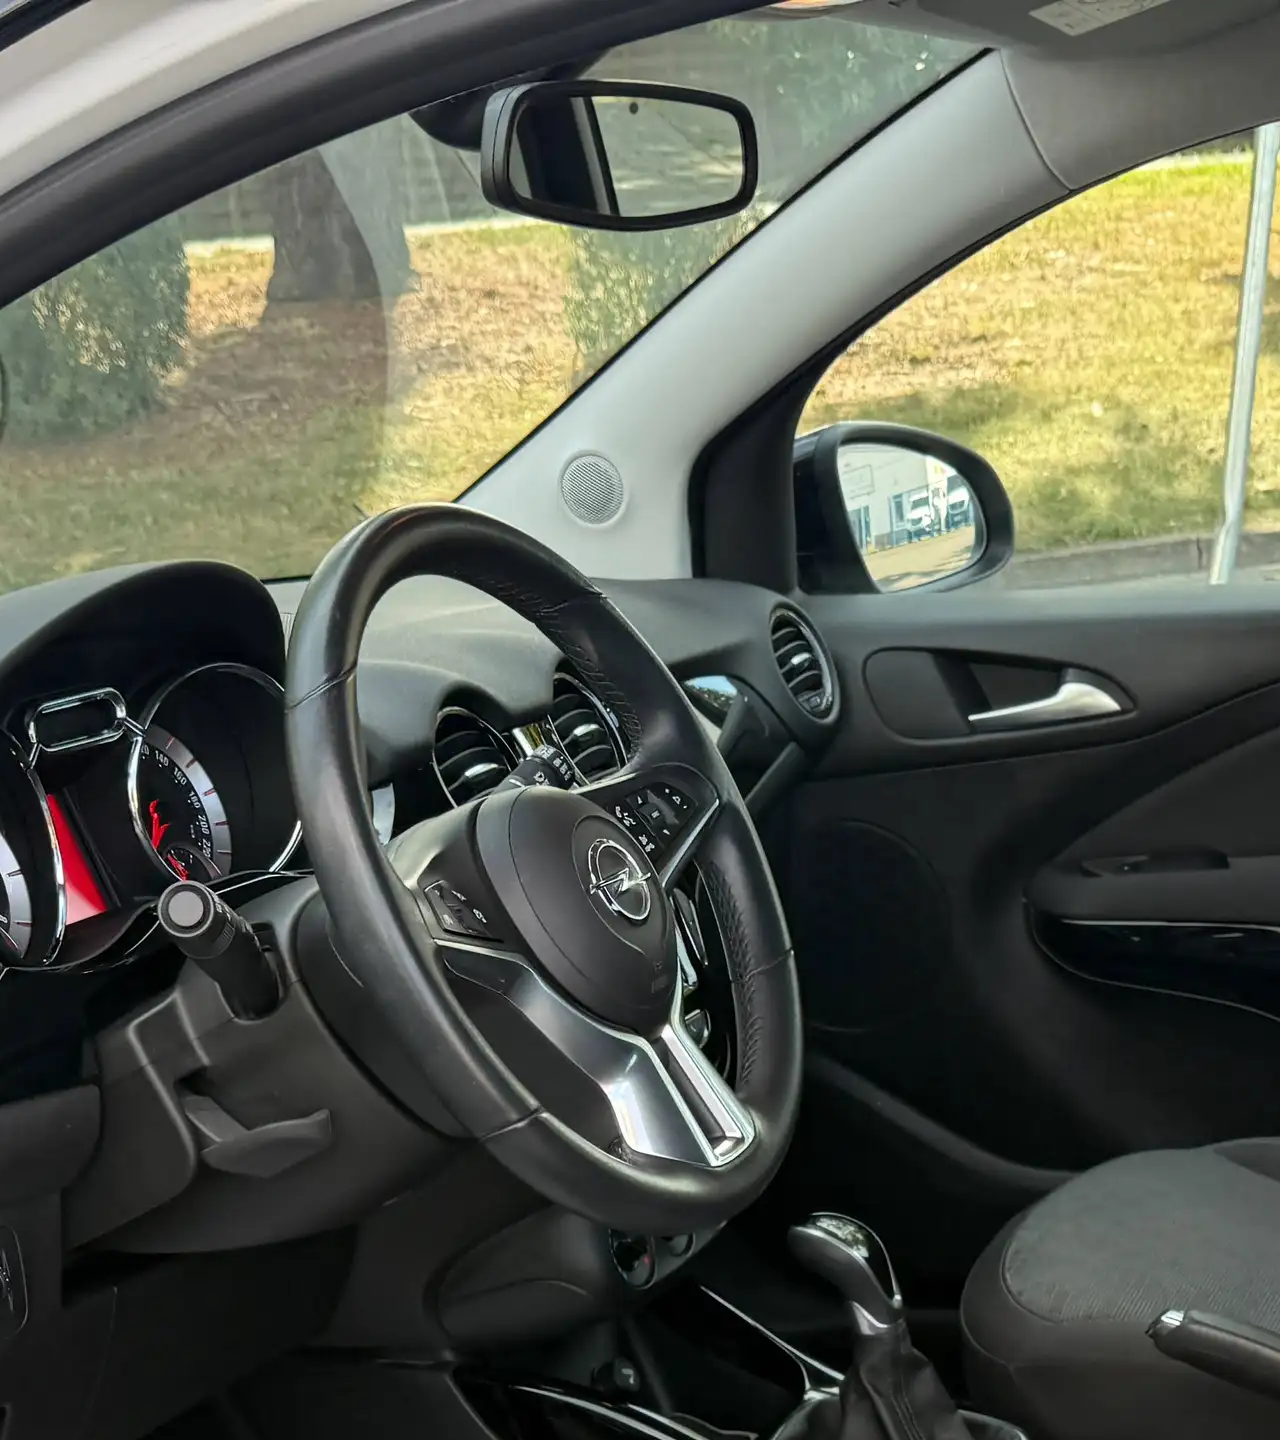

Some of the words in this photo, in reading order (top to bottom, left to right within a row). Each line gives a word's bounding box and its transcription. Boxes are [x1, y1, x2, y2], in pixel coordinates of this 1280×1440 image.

[155, 750, 169, 767] 140
[173, 767, 187, 786] 160
[188, 790, 201, 809] 180
